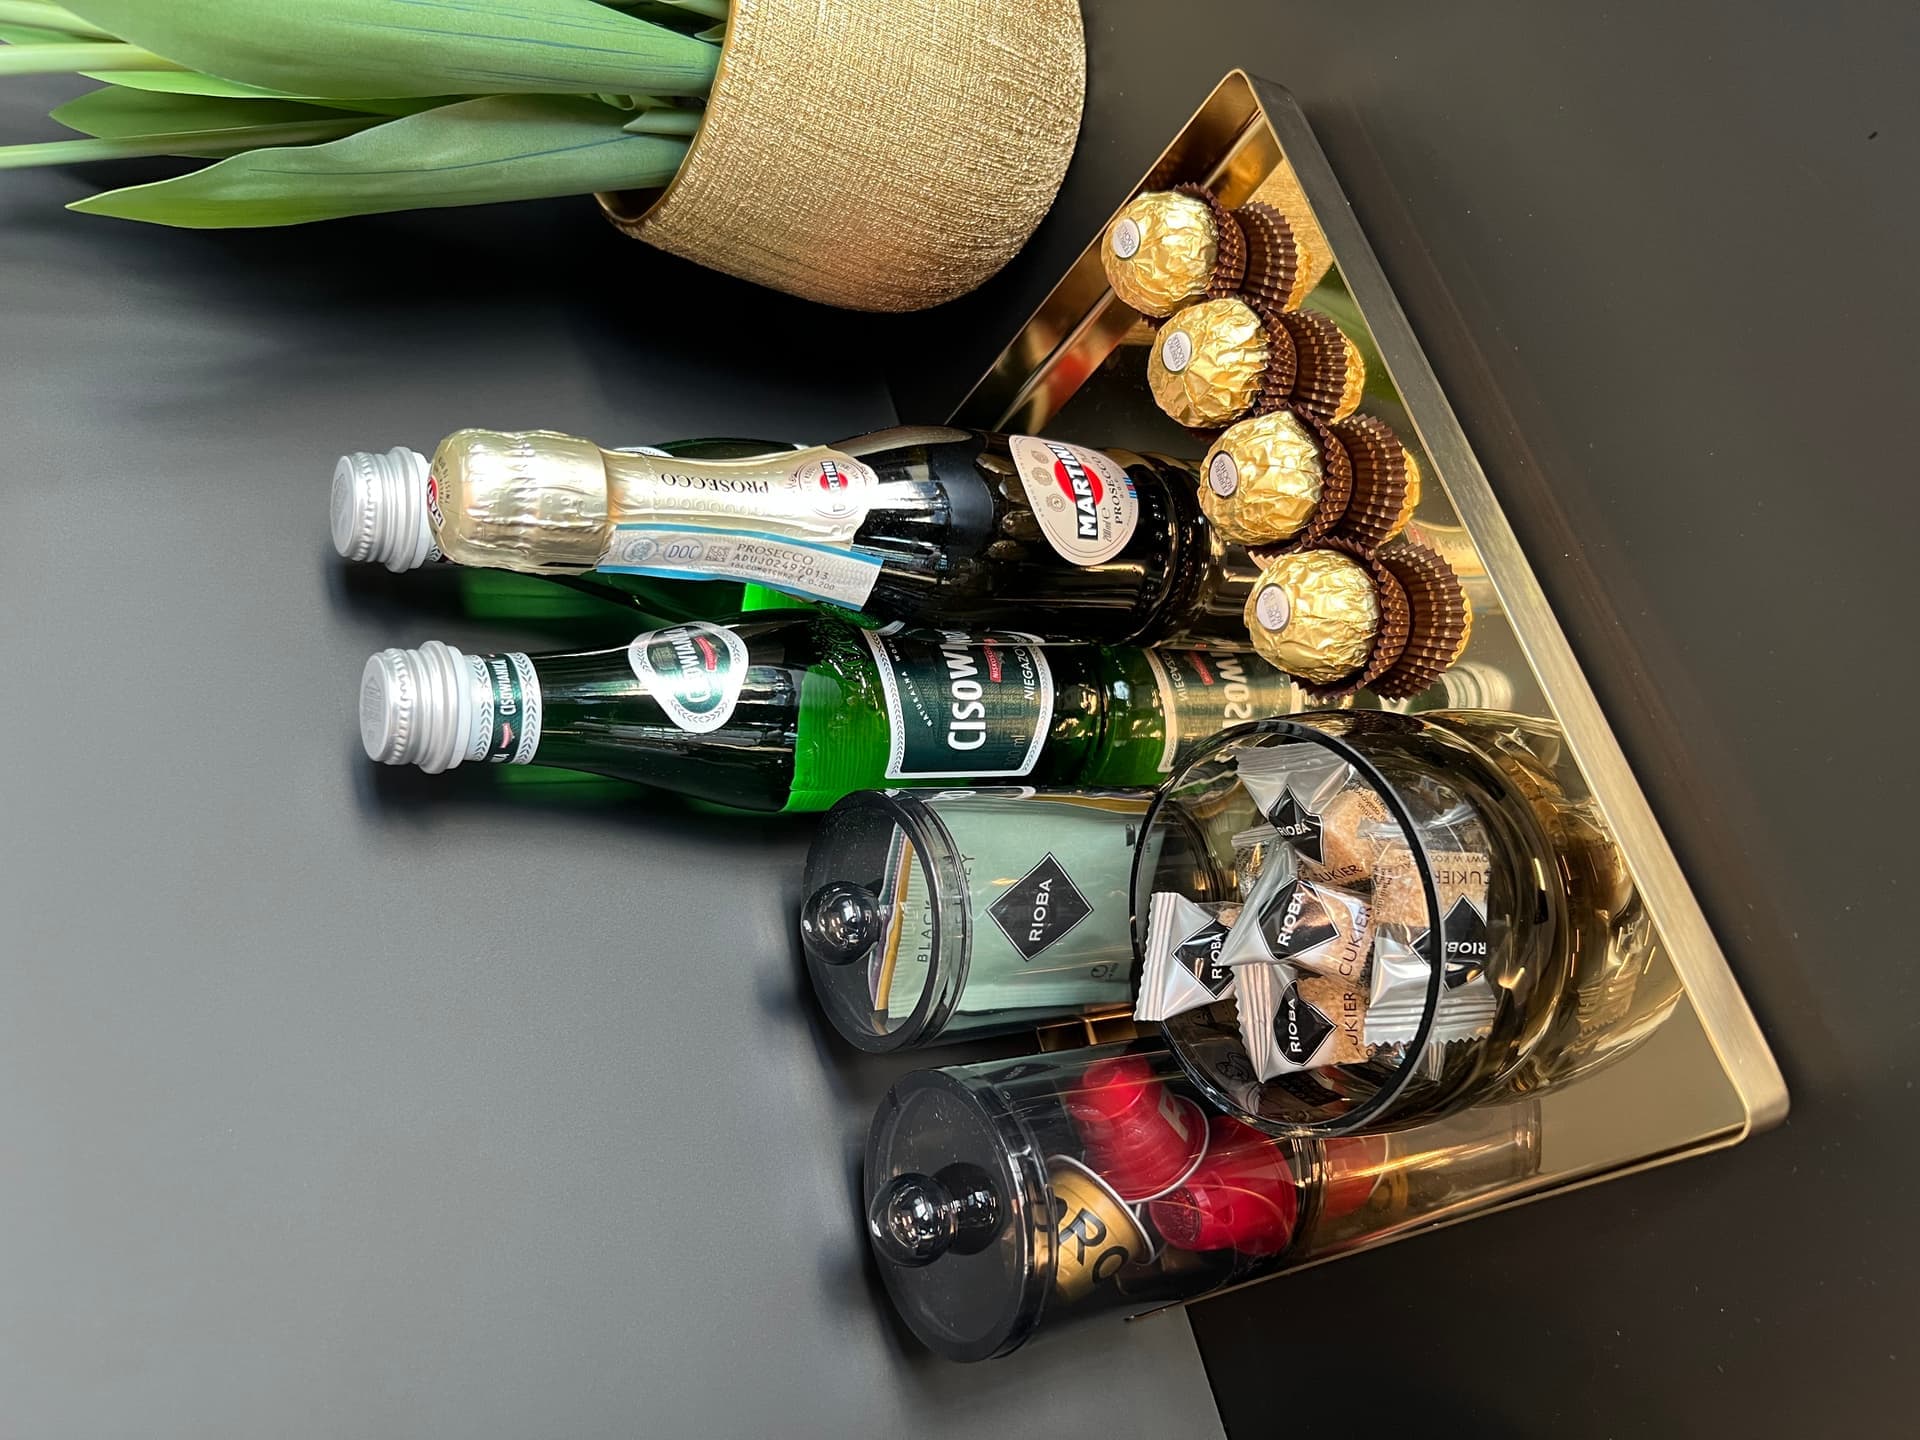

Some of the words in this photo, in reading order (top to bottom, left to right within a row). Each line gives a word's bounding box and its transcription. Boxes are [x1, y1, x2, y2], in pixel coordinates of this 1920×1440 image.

[661, 472, 769, 494] PROSECCO
[1046, 443, 1098, 537] MARTINI
[1091, 455, 1123, 525] PROSECCO
[668, 545, 699, 560] DOC
[737, 543, 814, 566] PROSECCO
[491, 659, 517, 716] CISOWIANKA
[940, 644, 987, 751] CISOWI
[1013, 648, 1035, 701] NIEGAZO
[1028, 878, 1053, 942] RIOBA
[1276, 890, 1306, 947] RIOBA
[1211, 932, 1222, 979] RIOBA
[1338, 905, 1372, 977] CUKIER
[1445, 941, 1487, 956] RIOB
[1289, 997, 1303, 1053] RIOBA
[1342, 991, 1358, 1046] UKIER
